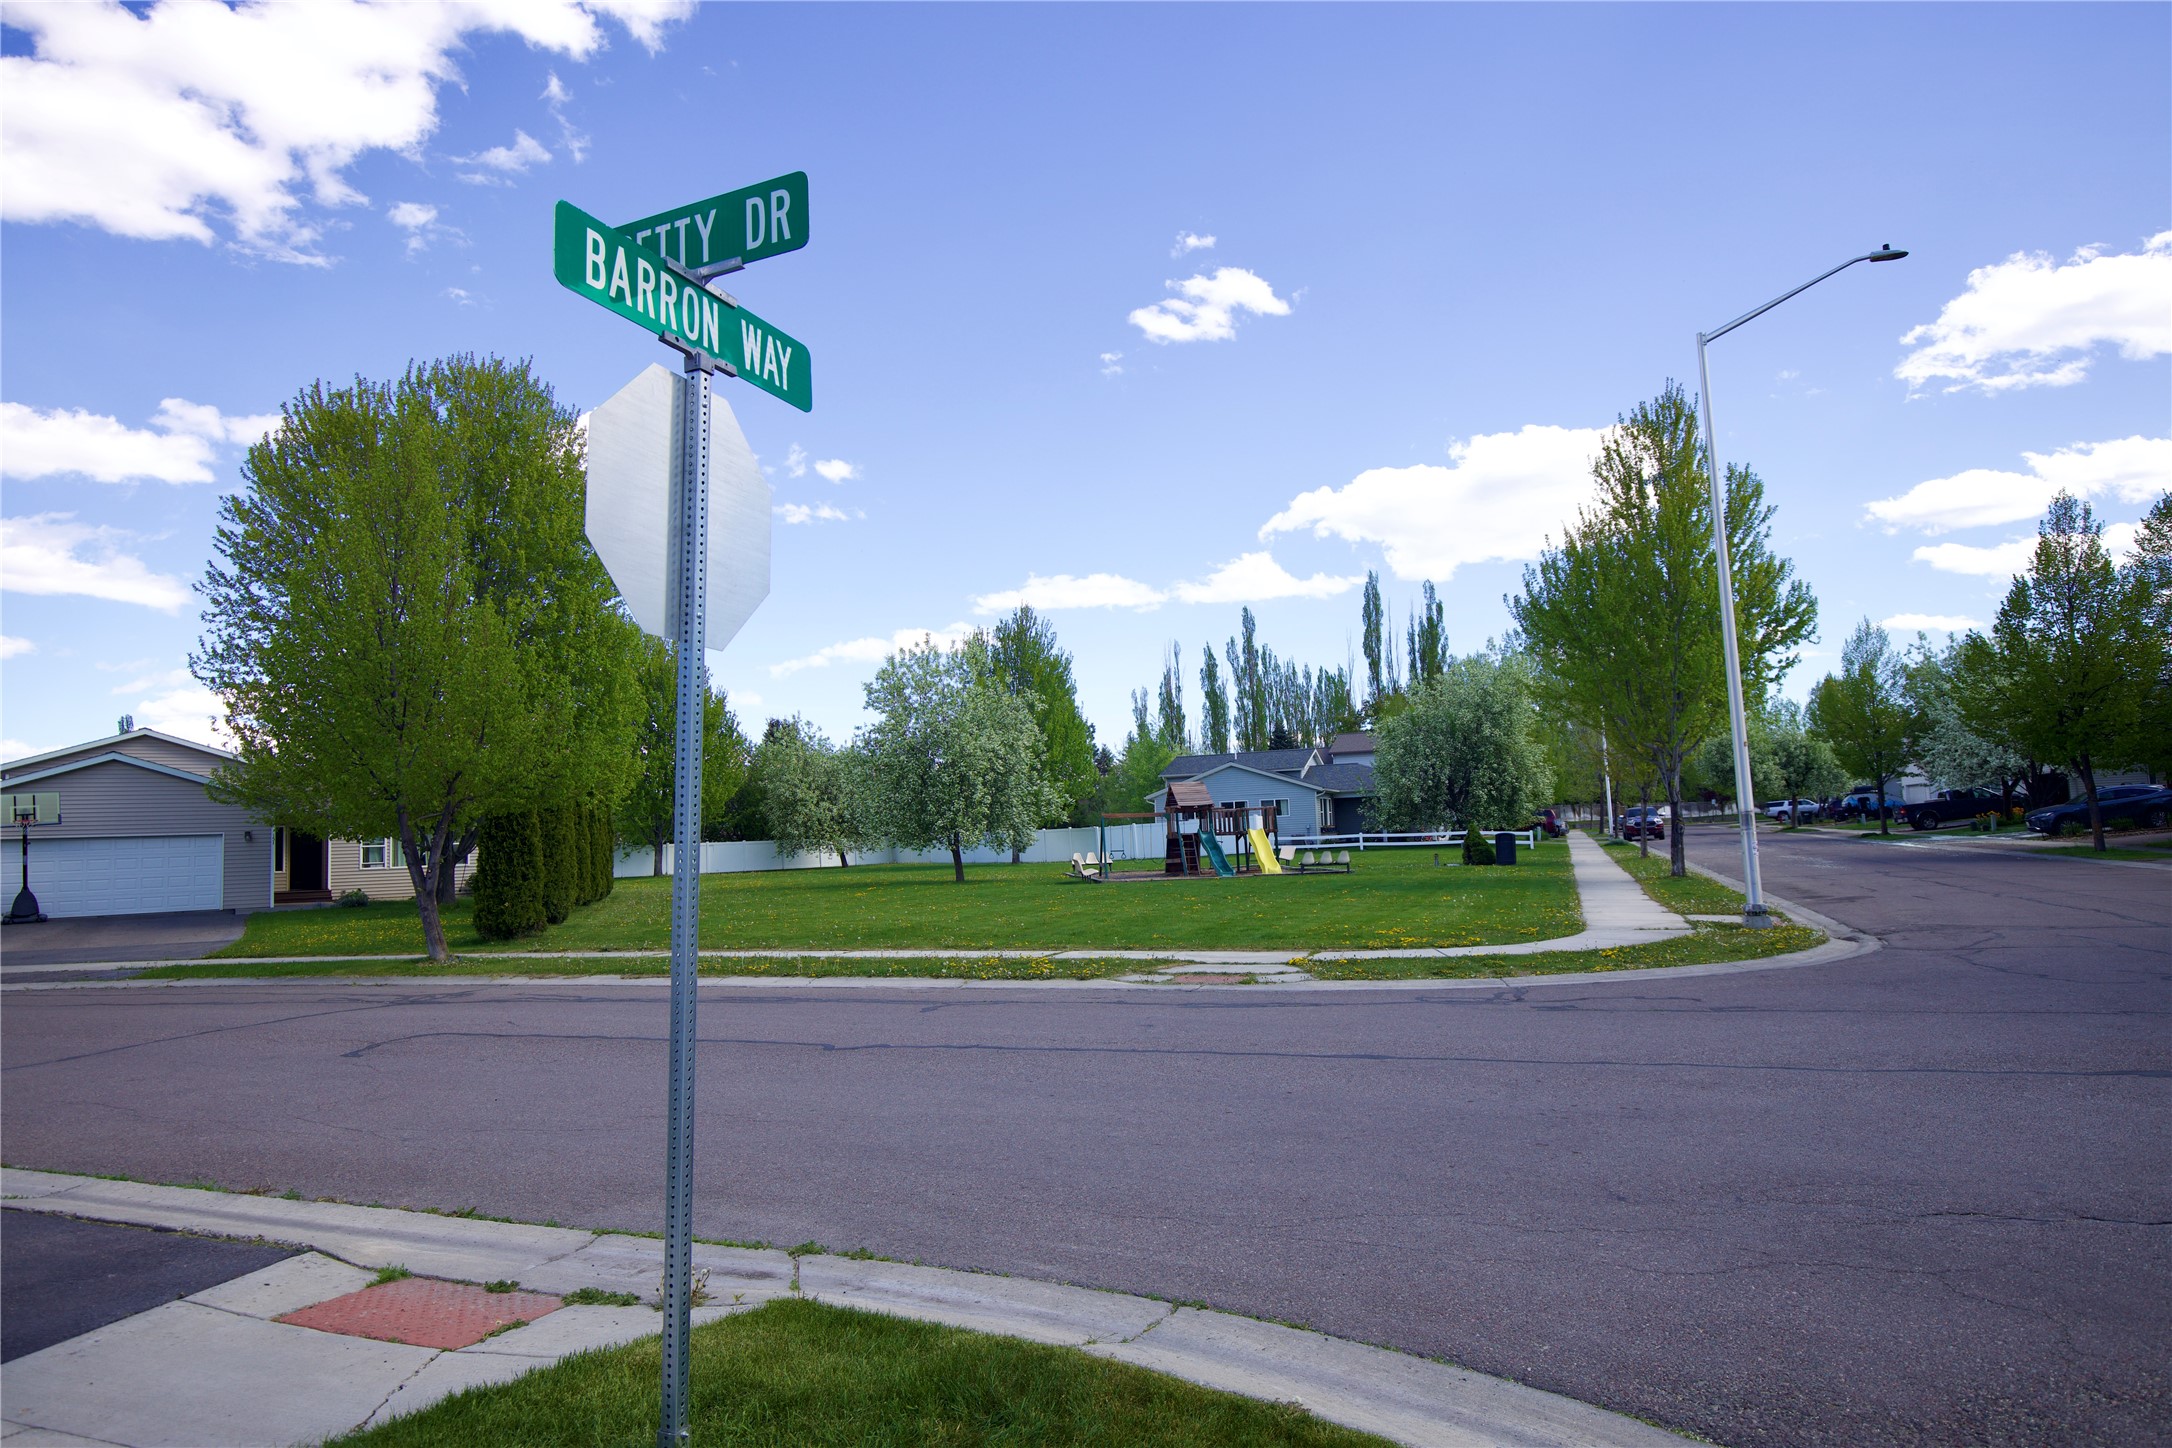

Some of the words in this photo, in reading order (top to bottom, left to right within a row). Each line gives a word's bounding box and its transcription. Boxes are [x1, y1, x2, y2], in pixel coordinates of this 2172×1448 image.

[625, 209, 717, 267] TTY
[745, 188, 791, 251] DR
[586, 227, 719, 354] BARRON
[741, 318, 792, 391] WAY
